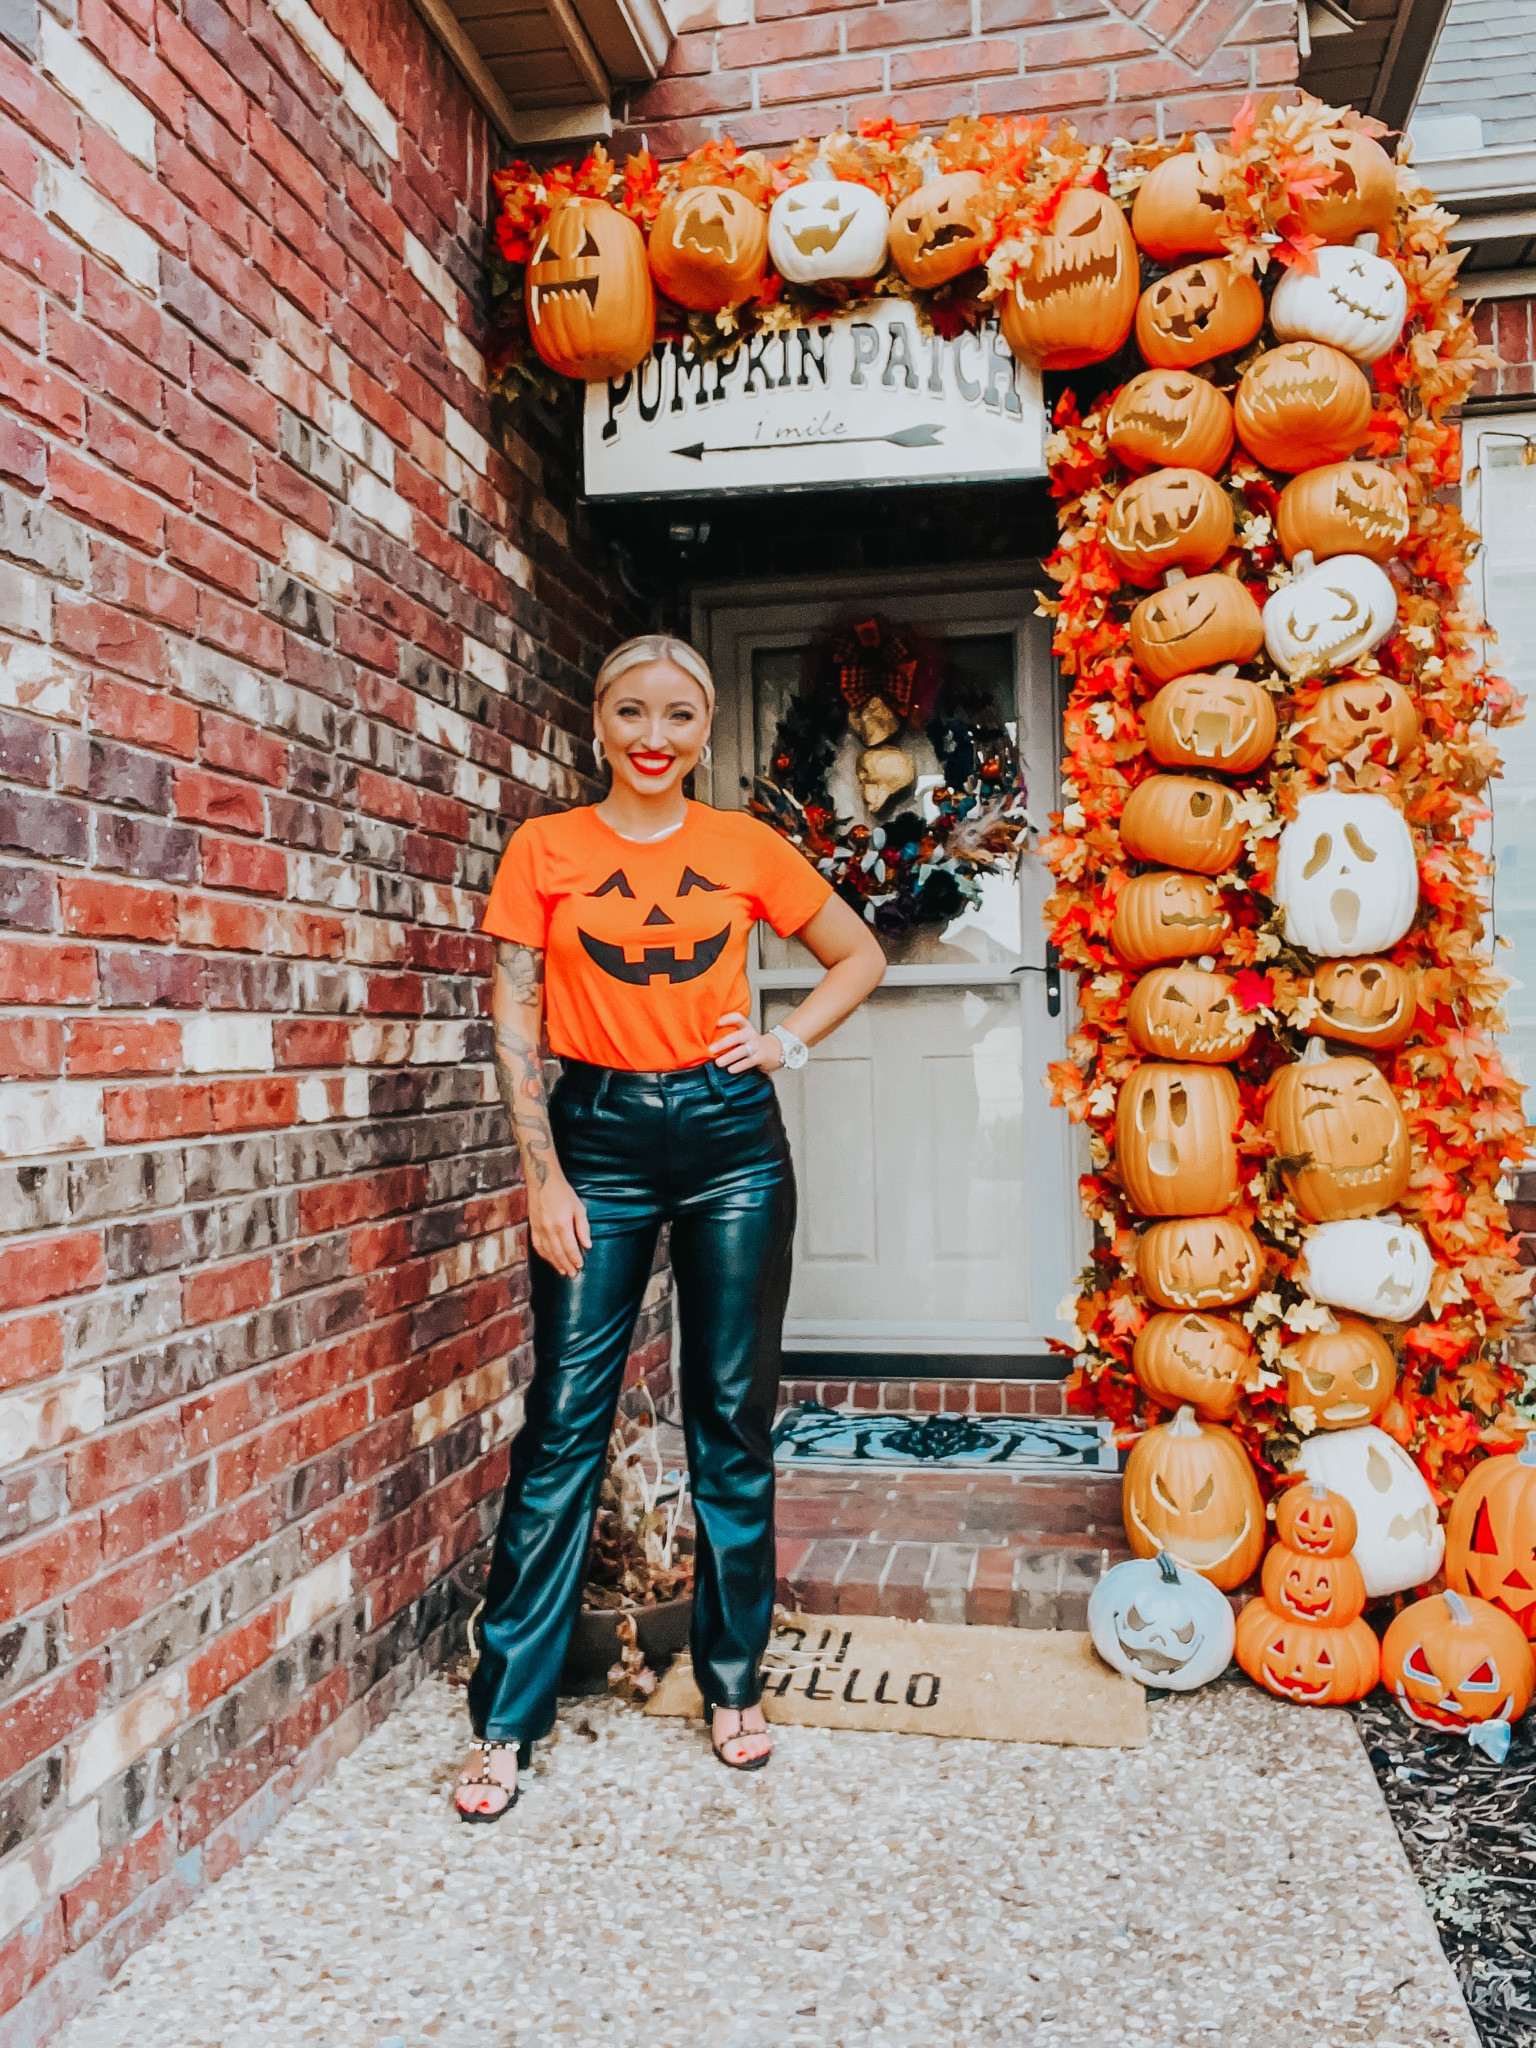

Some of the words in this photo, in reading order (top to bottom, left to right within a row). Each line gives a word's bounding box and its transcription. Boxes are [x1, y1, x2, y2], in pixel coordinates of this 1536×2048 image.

[602, 325, 832, 441] PUMPKIN
[850, 317, 1022, 414] PATCH
[776, 410, 848, 438] mile
[759, 1663, 941, 1708] HELLO
